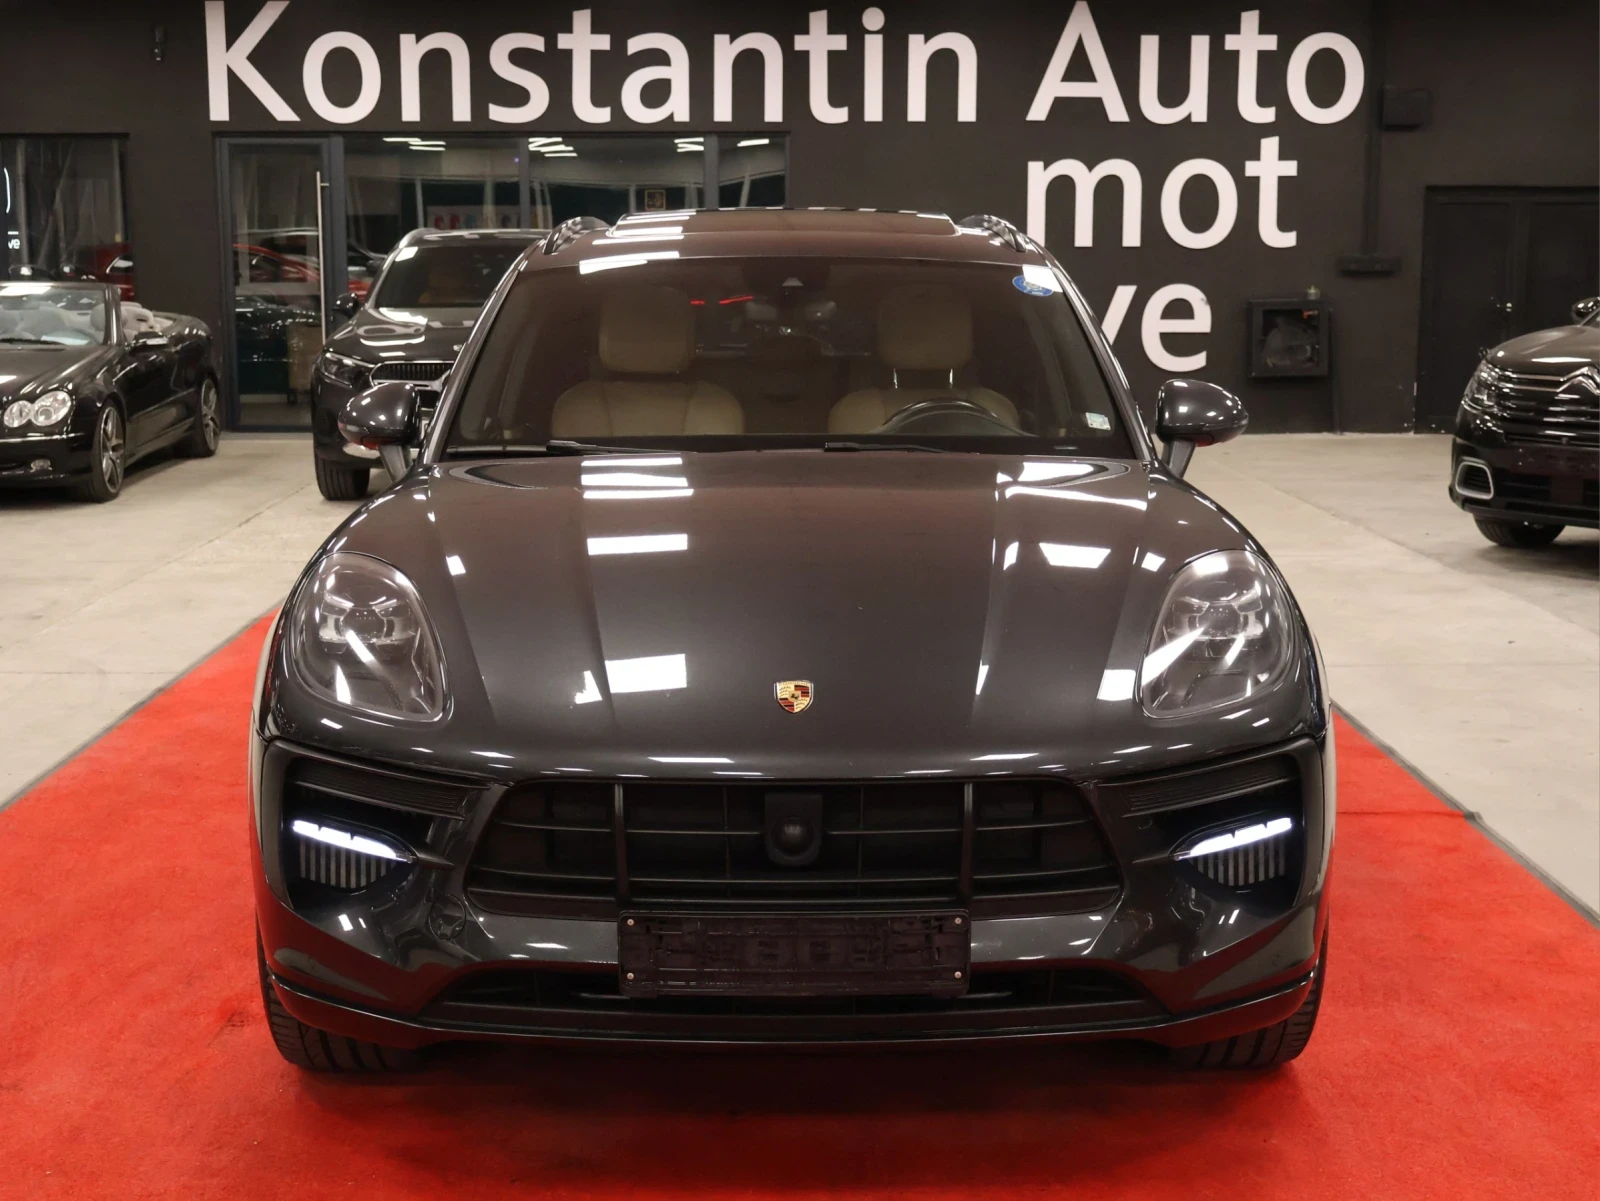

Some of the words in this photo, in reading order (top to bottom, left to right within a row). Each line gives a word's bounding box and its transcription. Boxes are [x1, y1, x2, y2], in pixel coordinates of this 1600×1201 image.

[205, 0, 978, 124] Konstantin
[1026, 0, 1365, 125] Auto
[1026, 136, 1298, 250] mot
